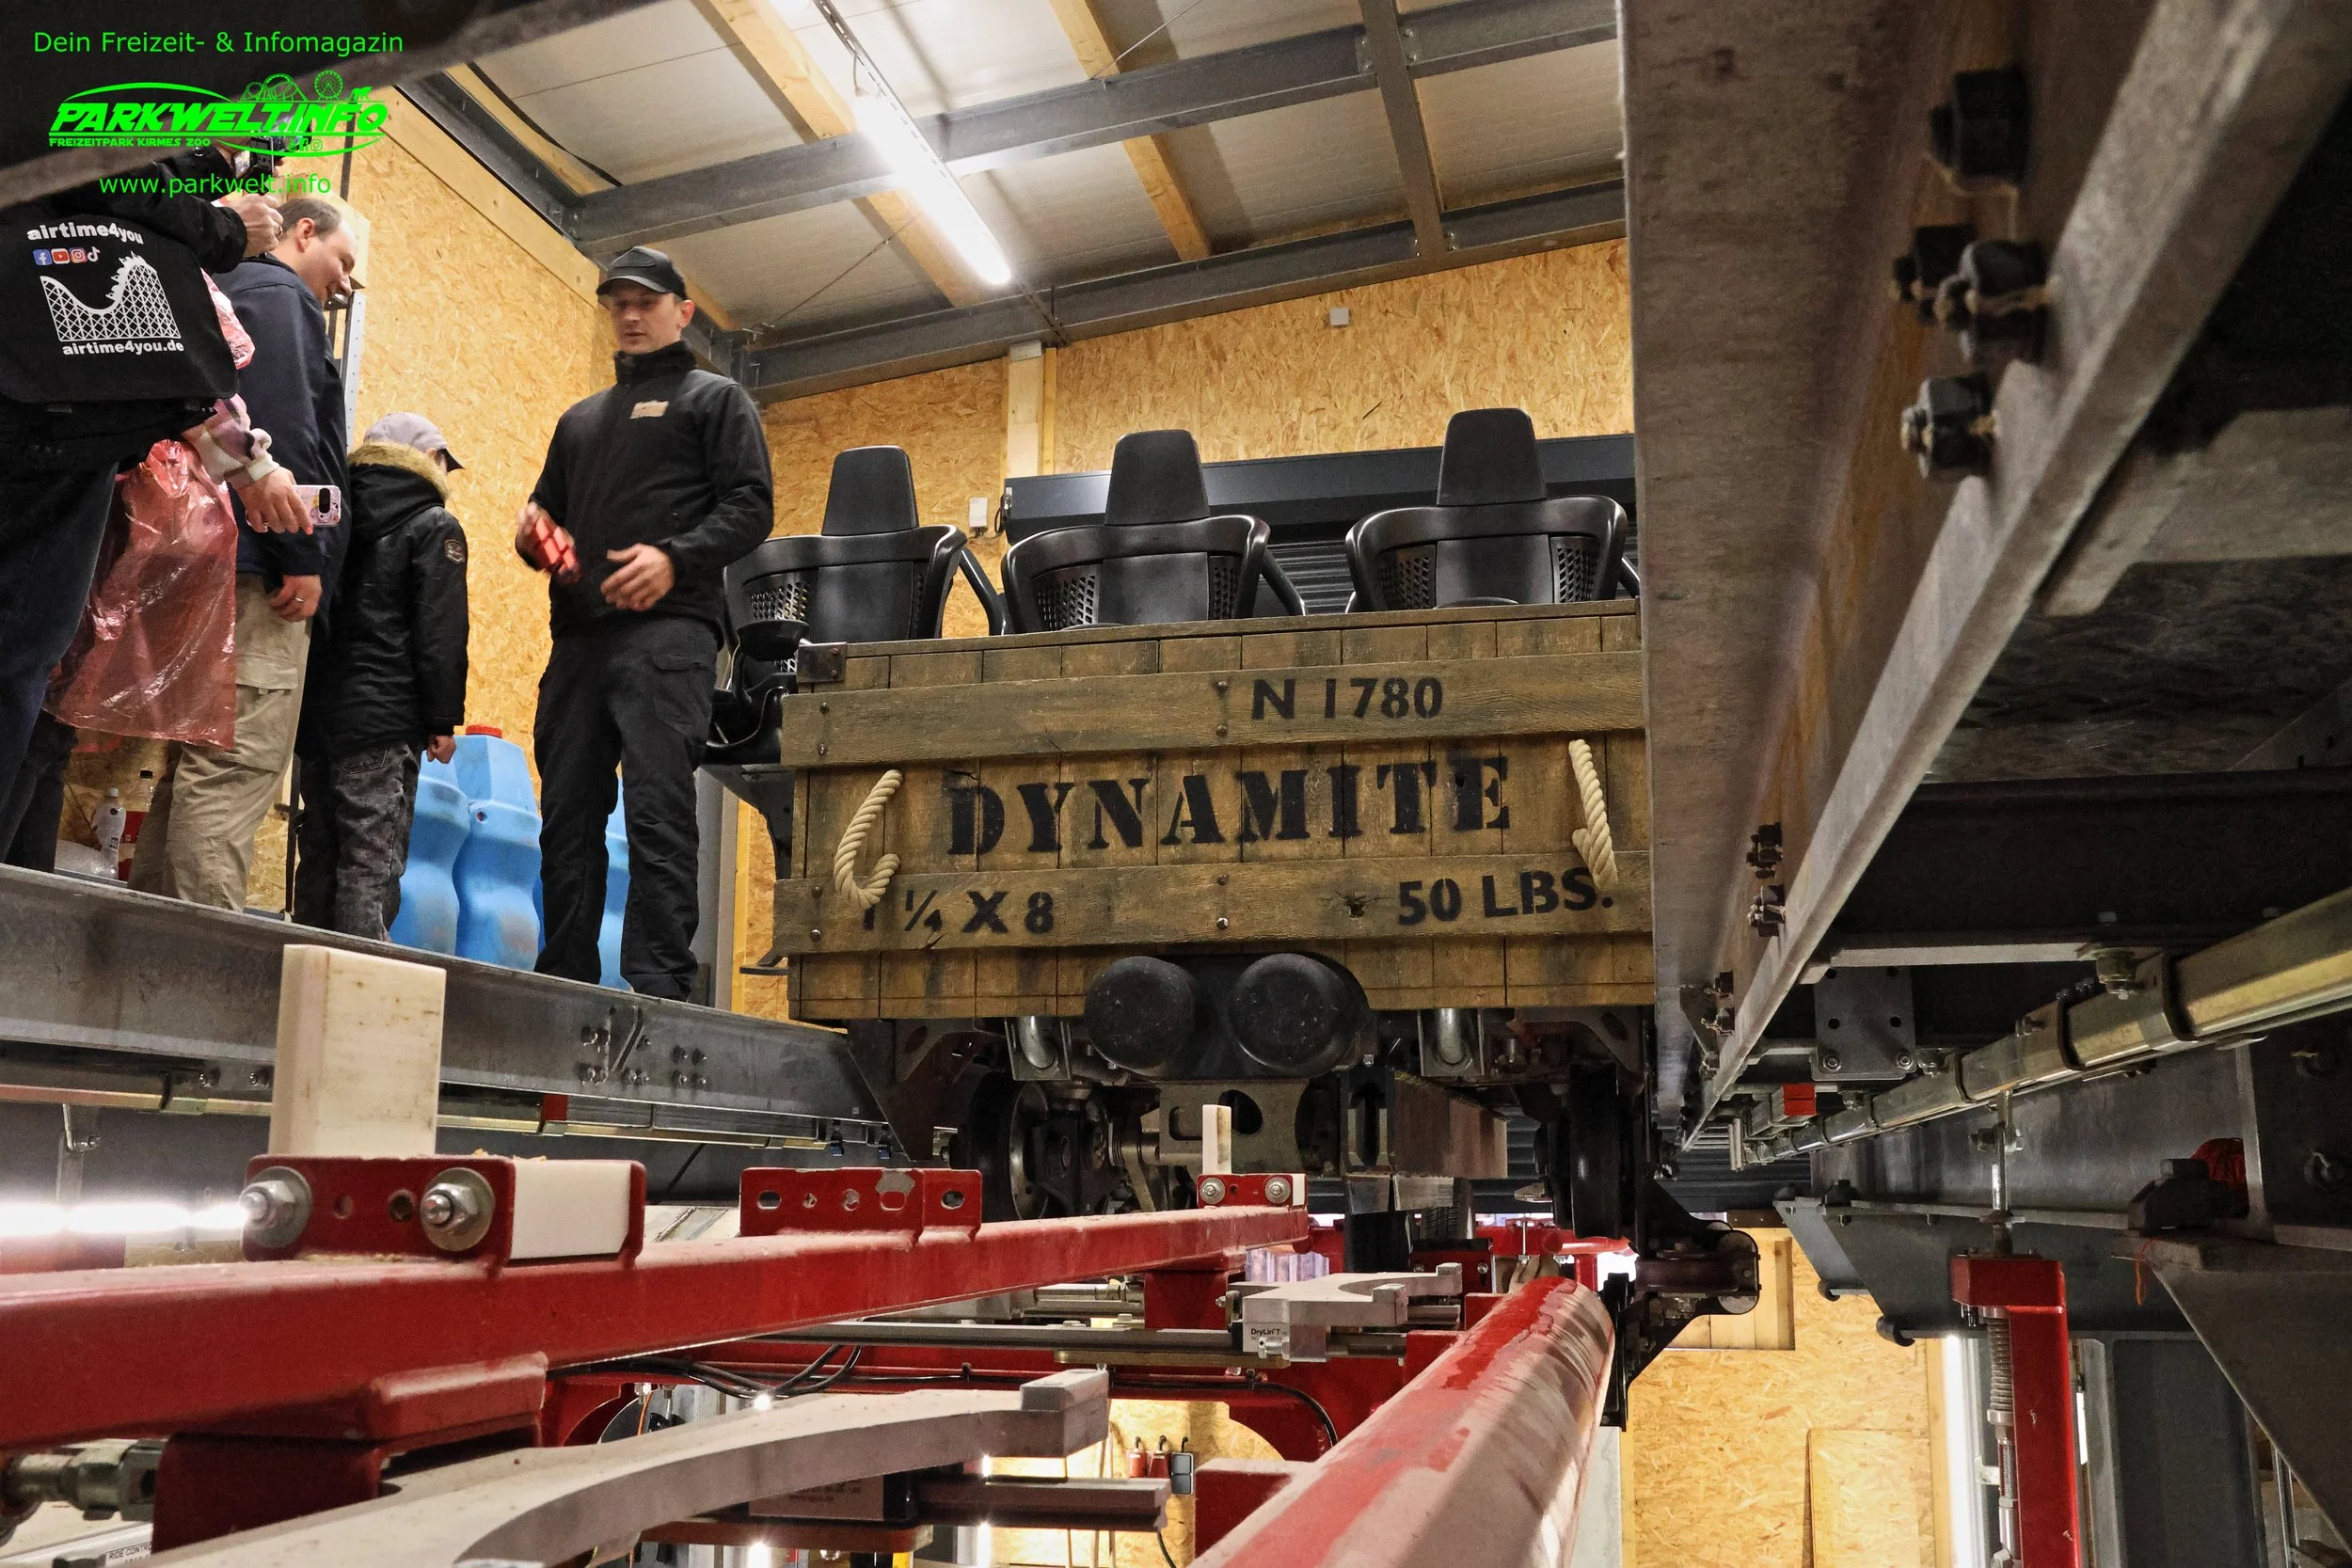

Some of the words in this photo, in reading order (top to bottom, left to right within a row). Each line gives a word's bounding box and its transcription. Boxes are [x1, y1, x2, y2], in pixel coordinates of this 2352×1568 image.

[26, 222, 144, 245] airtime4you
[62, 340, 184, 355] airtime4you.de
[1251, 678, 1296, 720] N
[1324, 676, 1444, 720] 1780
[946, 756, 1510, 855] DYNAMITE
[1025, 892, 1055, 934] 8
[1397, 877, 1463, 926] 50
[1482, 866, 1614, 918] LBS.
